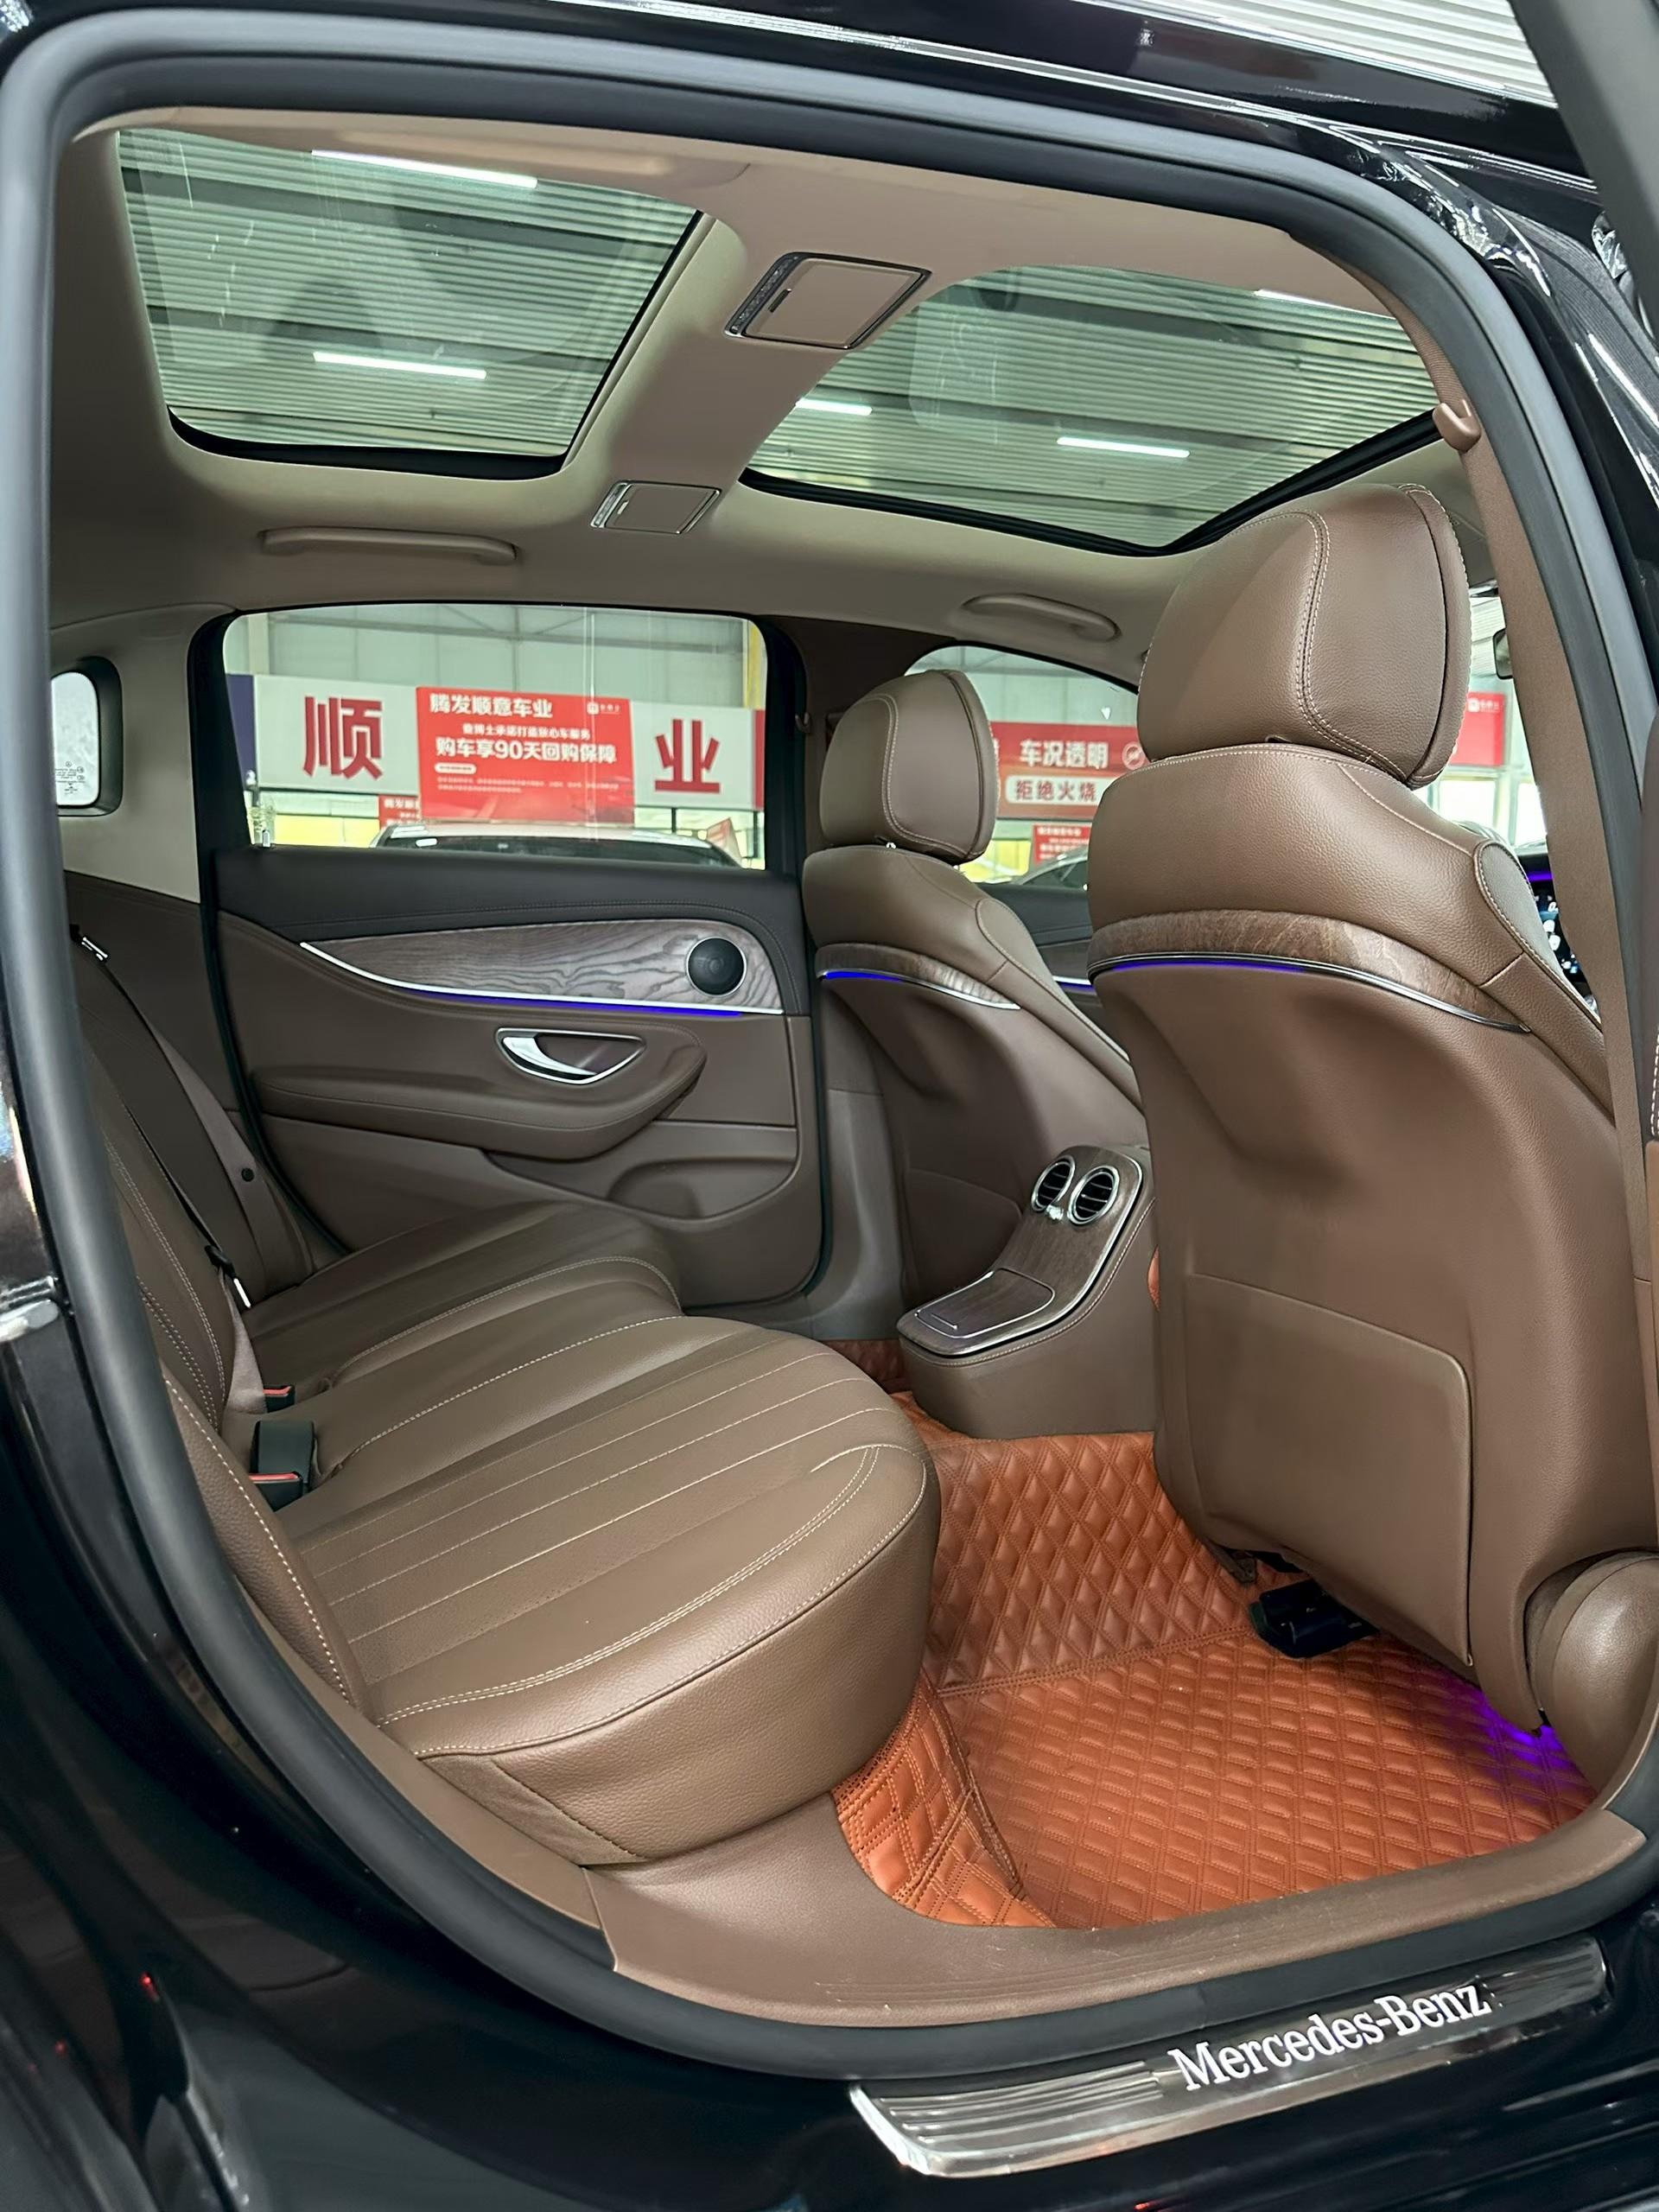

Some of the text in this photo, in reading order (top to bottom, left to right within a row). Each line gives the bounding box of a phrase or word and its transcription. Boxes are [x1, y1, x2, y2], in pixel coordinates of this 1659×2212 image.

[429, 693, 553, 718] 腾发顺意车业
[303, 696, 383, 780] 顺
[435, 736, 616, 764] 购车享90天回购保障
[655, 719, 720, 793] 业
[1020, 739, 1109, 770] 车况透明
[1016, 780, 1096, 802] 拒绝火烧
[1167, 1985, 1492, 2091] Mercedes-Benz
